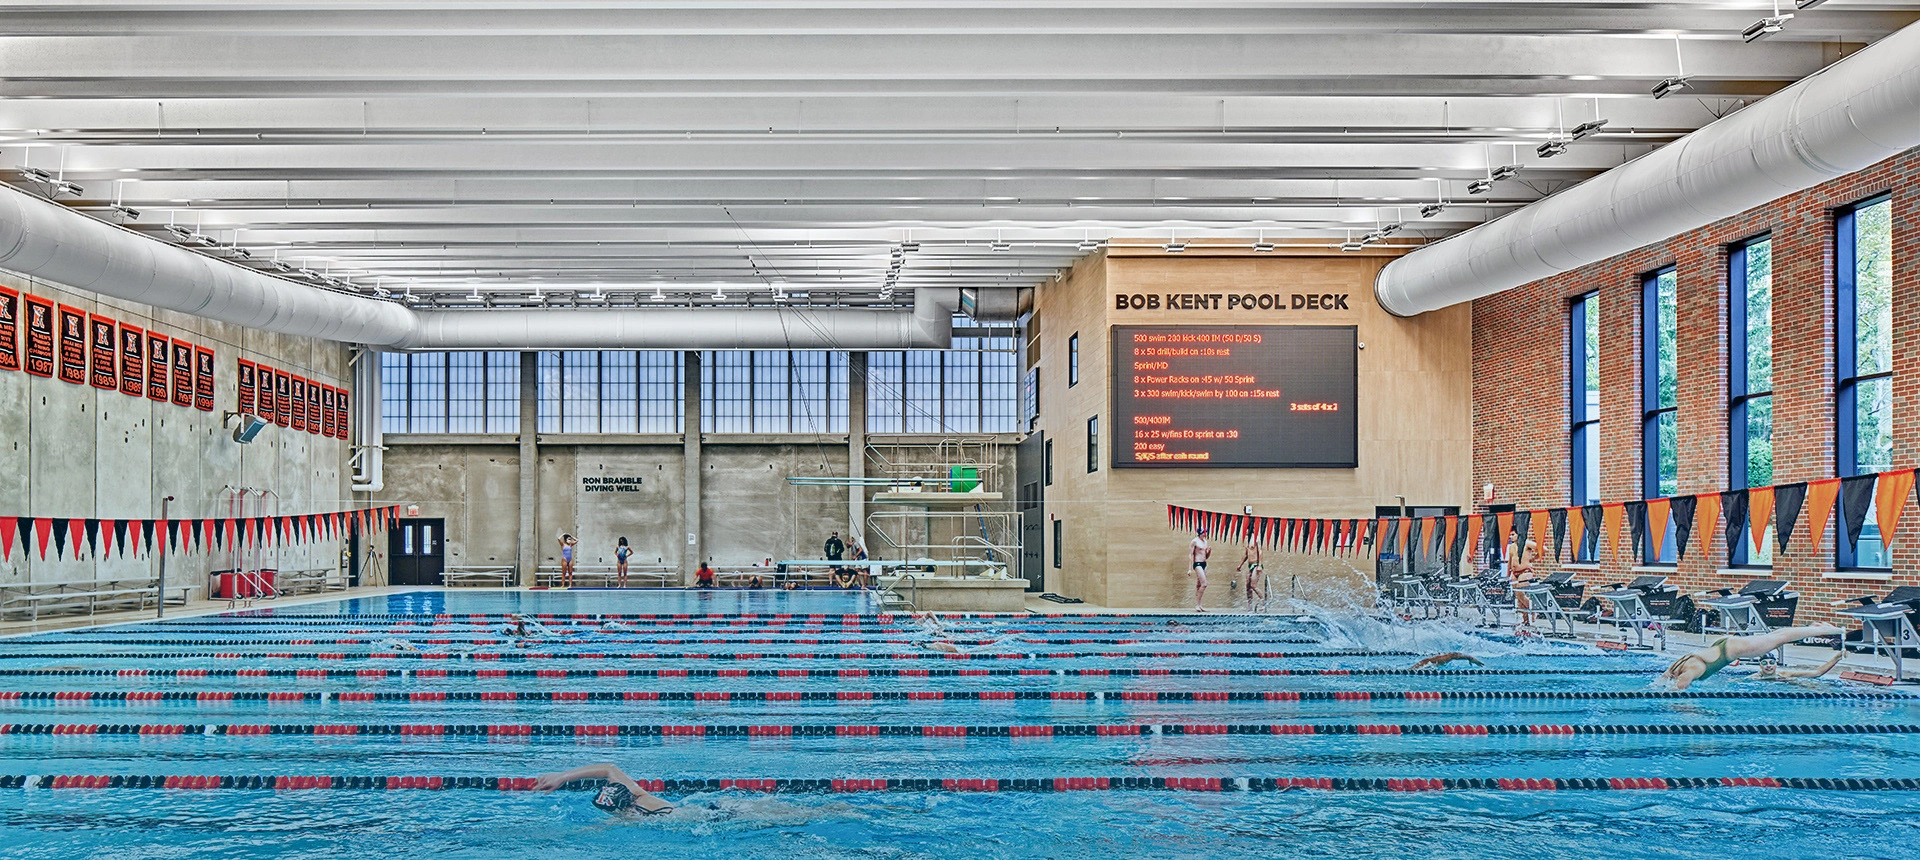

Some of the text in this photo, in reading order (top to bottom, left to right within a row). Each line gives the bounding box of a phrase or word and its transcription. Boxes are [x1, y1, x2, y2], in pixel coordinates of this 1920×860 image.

[1116, 294, 1348, 310] BOB KENT POOL DECK
[1134, 335, 1147, 343] 500
[1149, 335, 1166, 343] swim
[1182, 335, 1196, 343] kick
[1197, 335, 1209, 343] 400
[1212, 335, 1220, 343] IM
[1222, 335, 1234, 343] (50
[1236, 335, 1252, 343] D/50
[1254, 335, 1261, 343] S)
[1134, 348, 1139, 356] 8
[1141, 348, 1146, 356] x
[1190, 348, 1198, 356] on
[31, 358, 53, 373] 1987
[1134, 362, 1168, 370] Sprint/MD
[94, 375, 116, 386] 1989
[1134, 376, 1139, 384] 8
[1141, 376, 1146, 384] x
[1147, 376, 1168, 384] Power
[1169, 376, 1189, 384] Racks
[1190, 376, 1199, 384] on
[1202, 376, 1212, 384] :45
[1214, 376, 1222, 384] w/
[1235, 376, 1255, 384] Sprint
[1134, 390, 1139, 398] 3
[1141, 390, 1146, 398] x
[1161, 390, 1213, 398] swim/kick/swim
[1215, 390, 1223, 398] by
[1225, 390, 1238, 398] 100
[1239, 390, 1248, 398] on
[1250, 390, 1265, 398] :15s
[1134, 416, 1170, 424] 500/400IM
[1135, 430, 1238, 439] 16 x 25 w/fins EO sprint on :30
[1637, 607, 1642, 616] 5
[1750, 617, 1756, 626] 4
[1903, 629, 1910, 640] 3
